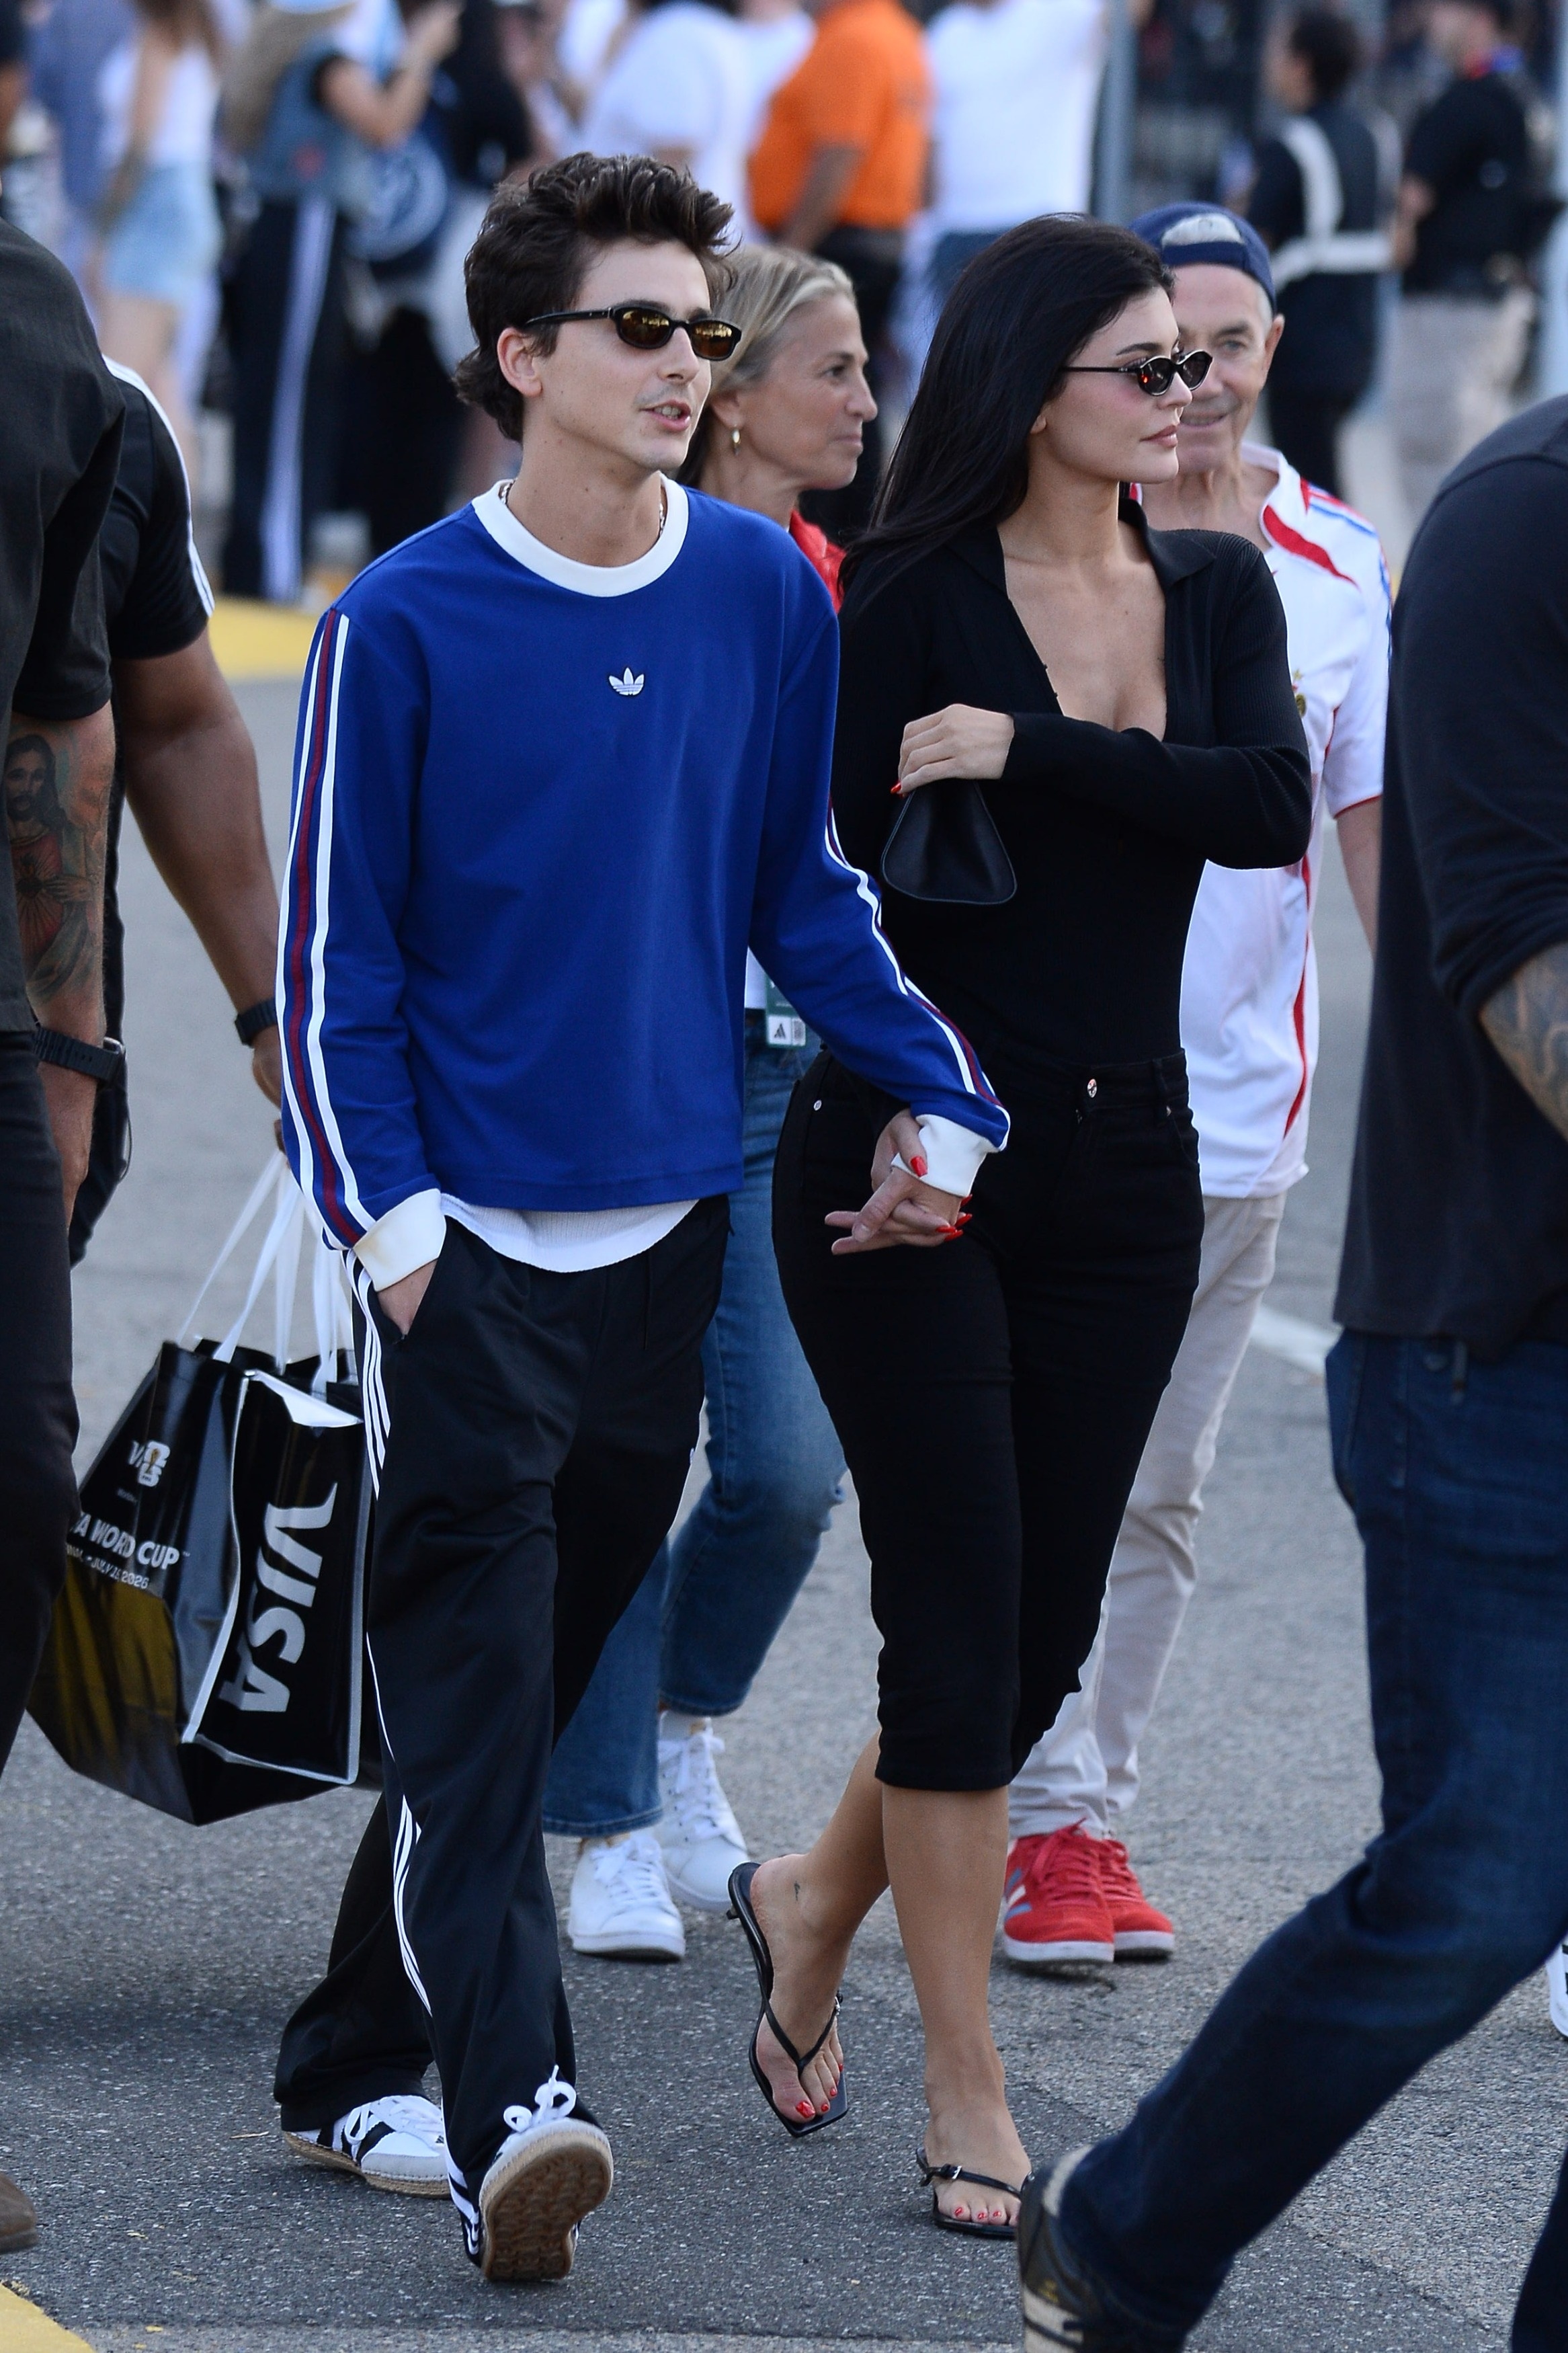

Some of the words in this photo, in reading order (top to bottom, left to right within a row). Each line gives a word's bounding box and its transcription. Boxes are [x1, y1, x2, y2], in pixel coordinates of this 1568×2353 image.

[90, 1519, 136, 1558] WORD
[121, 1570, 149, 1589] 2026
[218, 1482, 337, 1712] VISA
